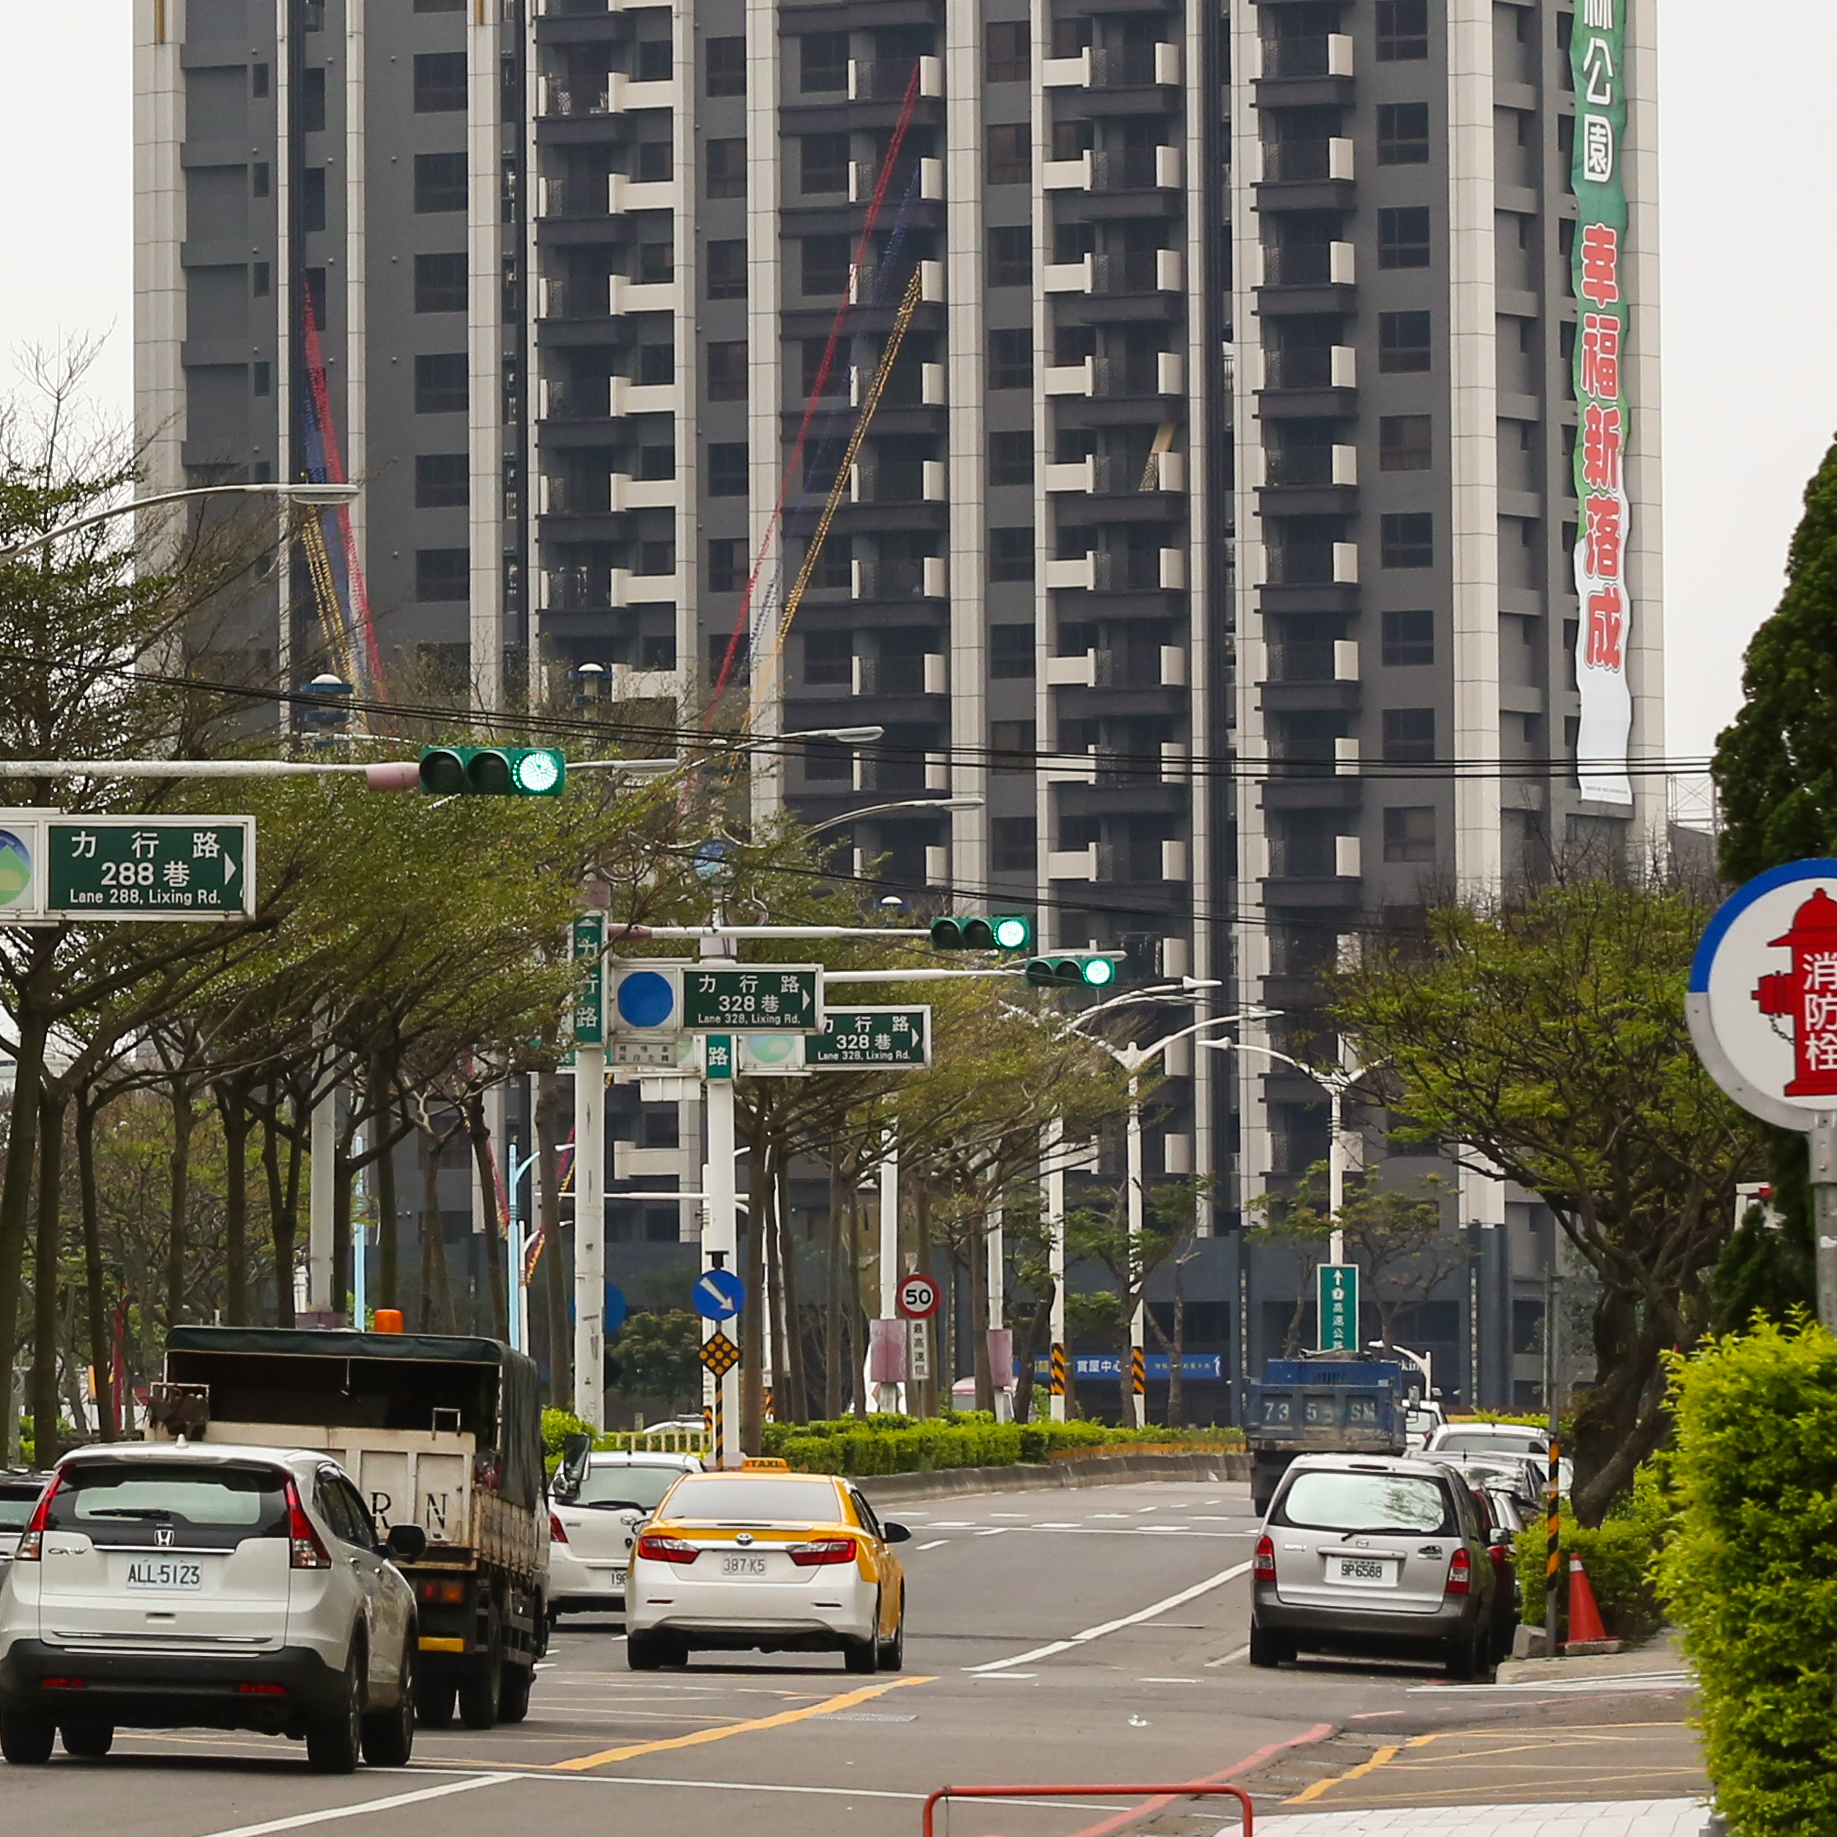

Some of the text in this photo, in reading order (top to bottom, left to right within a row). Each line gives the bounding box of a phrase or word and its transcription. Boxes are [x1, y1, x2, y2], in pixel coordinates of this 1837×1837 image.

[1580, 221, 1623, 673] 幸福新落成
[71, 831, 220, 859] 力行路
[69, 889, 221, 906] Lane 288, Lixing Rd.
[698, 974, 800, 994] 力行路
[698, 1013, 801, 1026] Lane 328, Lixing Rd.
[1803, 952, 1837, 1071] 消防栓
[708, 1046, 728, 1067] 路
[817, 1051, 839, 1060] Lane
[866, 1051, 893, 1062] Lixing
[895, 1051, 910, 1060] Rd.
[905, 1289, 931, 1305] 50
[128, 1564, 200, 1584] ALL-5123
